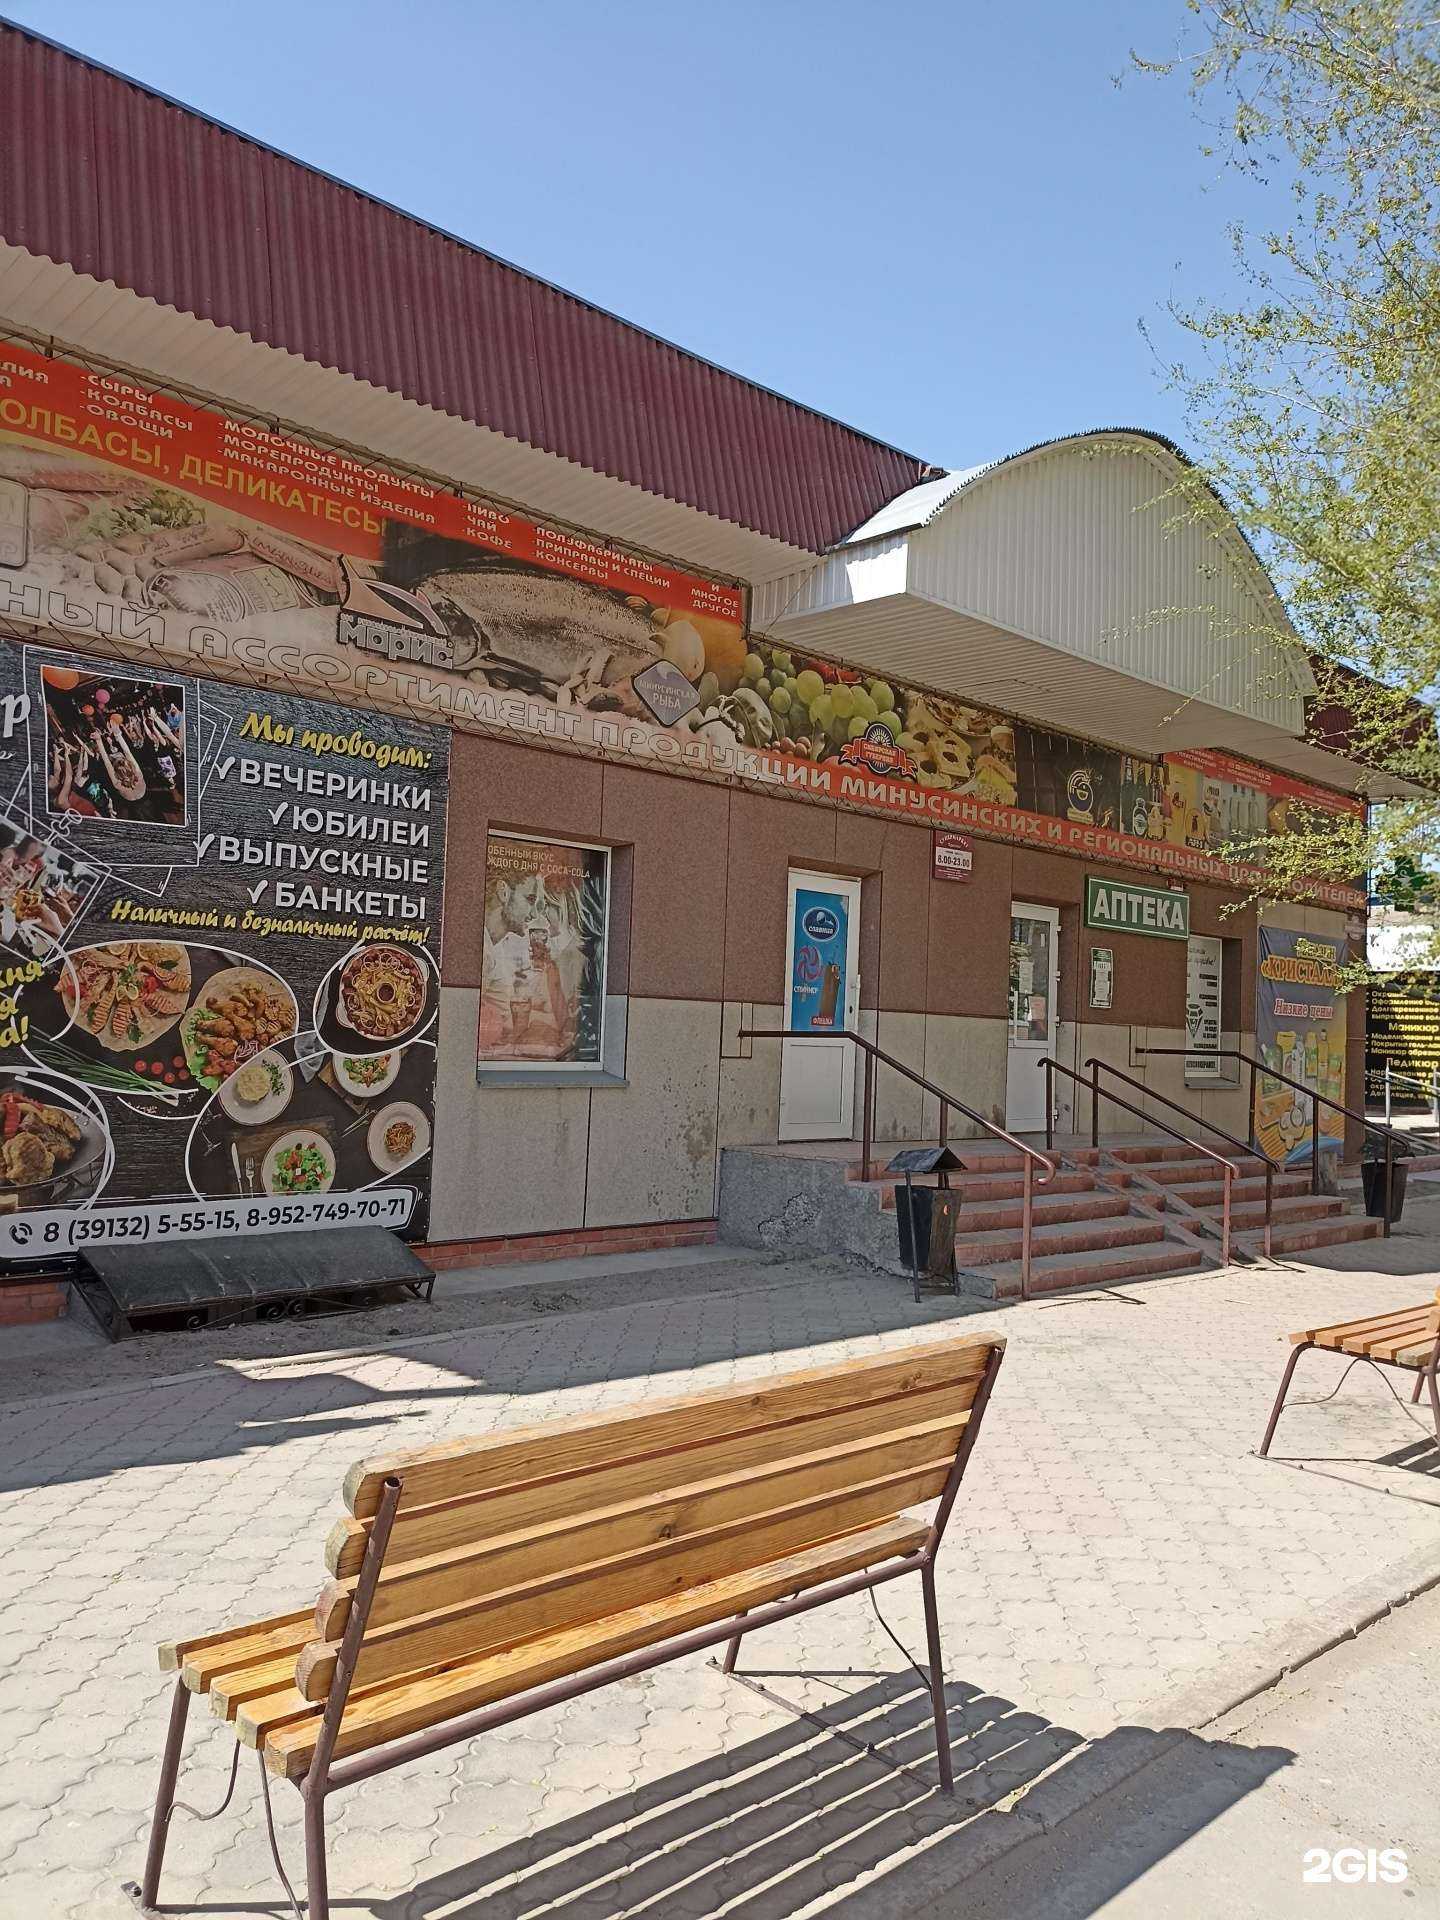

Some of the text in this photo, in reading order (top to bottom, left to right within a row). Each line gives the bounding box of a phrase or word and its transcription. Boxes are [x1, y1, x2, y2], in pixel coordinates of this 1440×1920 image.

[179, 453, 386, 537] ДЕЛИКАТЕСЫ
[341, 460, 435, 499] ПРОДУКТЫ
[360, 491, 436, 525] ИЗДЕЛИЯ
[612, 562, 621, 573] И
[623, 567, 671, 589] СПЕЦИИ
[711, 583, 720, 593] И
[691, 587, 740, 609] МНОГОЕ
[692, 599, 737, 618] ДРУГОЕ
[188, 625, 581, 738] АССОРТИМЕНТ
[593, 718, 831, 790] ПРОДУКЦИИ
[840, 774, 1043, 836] МИНУСИНСКИХ
[1048, 822, 1062, 841] И
[1069, 827, 1224, 879] РЕГИОНАЛЬНЫХ
[239, 712, 432, 768] Мы проводим:
[239, 758, 431, 811] ВЕЧЕРИНКИ
[292, 805, 430, 848] ЮБИЛЕИ
[219, 835, 429, 883] ВЫПУСКНЫЕ
[521, 860, 538, 872] ДНЯ
[547, 865, 591, 879] COCA-COLA
[533, 851, 555, 862] ВКУС
[111, 899, 218, 928] Наличный
[223, 915, 237, 930] и
[241, 909, 358, 938] безналичный
[275, 881, 426, 919] БАНКЕТЫ
[1093, 888, 1185, 930] АПТЕКА
[1274, 999, 1308, 1017] Низкие
[1388, 1022, 1440, 1034] Маникюр
[1386, 1057, 1439, 1069] Педикюр
[43, 1197, 406, 1245] 8 (39132) 5-55-15, 8-952-749-70-71
